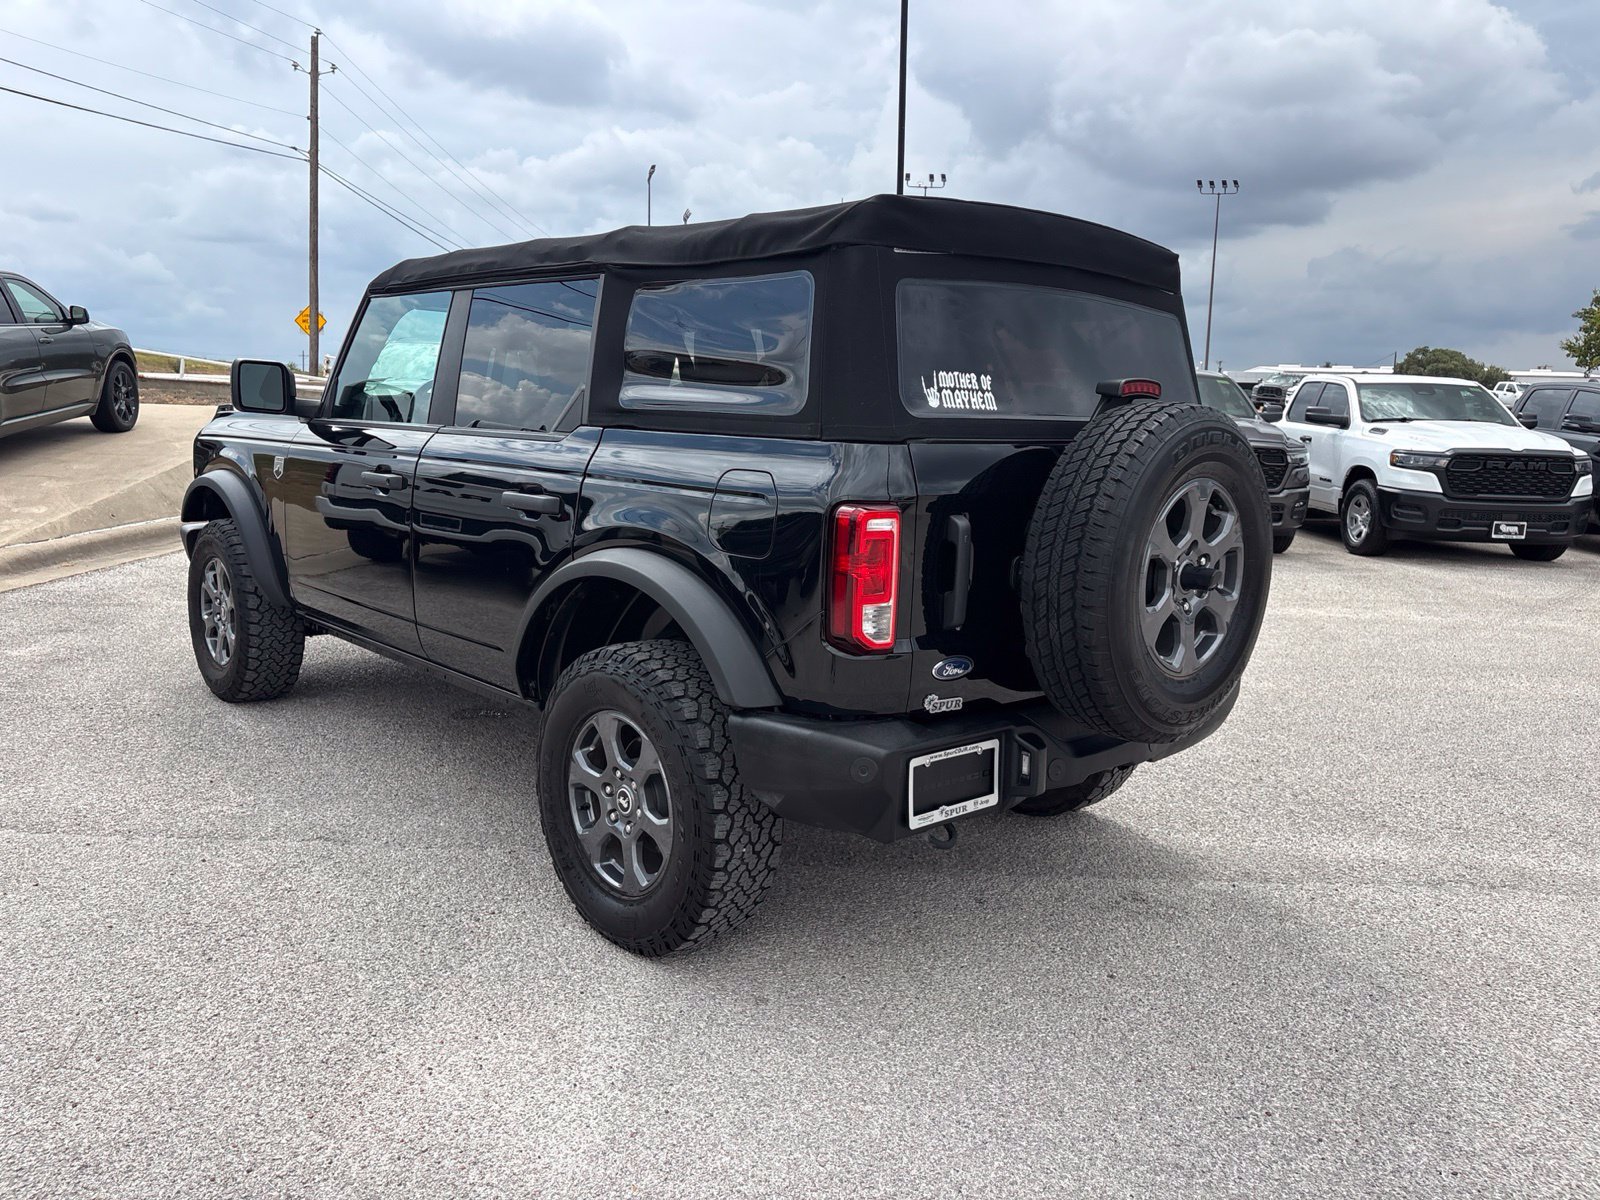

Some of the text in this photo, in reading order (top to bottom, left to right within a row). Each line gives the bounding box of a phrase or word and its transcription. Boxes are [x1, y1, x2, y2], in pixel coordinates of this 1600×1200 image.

[938, 371, 991, 390] MOTHER OF
[941, 389, 998, 411] MAYHEM
[1486, 460, 1547, 470] RAM
[943, 663, 965, 676] Ford
[931, 699, 962, 712] SPUR
[944, 805, 968, 818] SPUR
